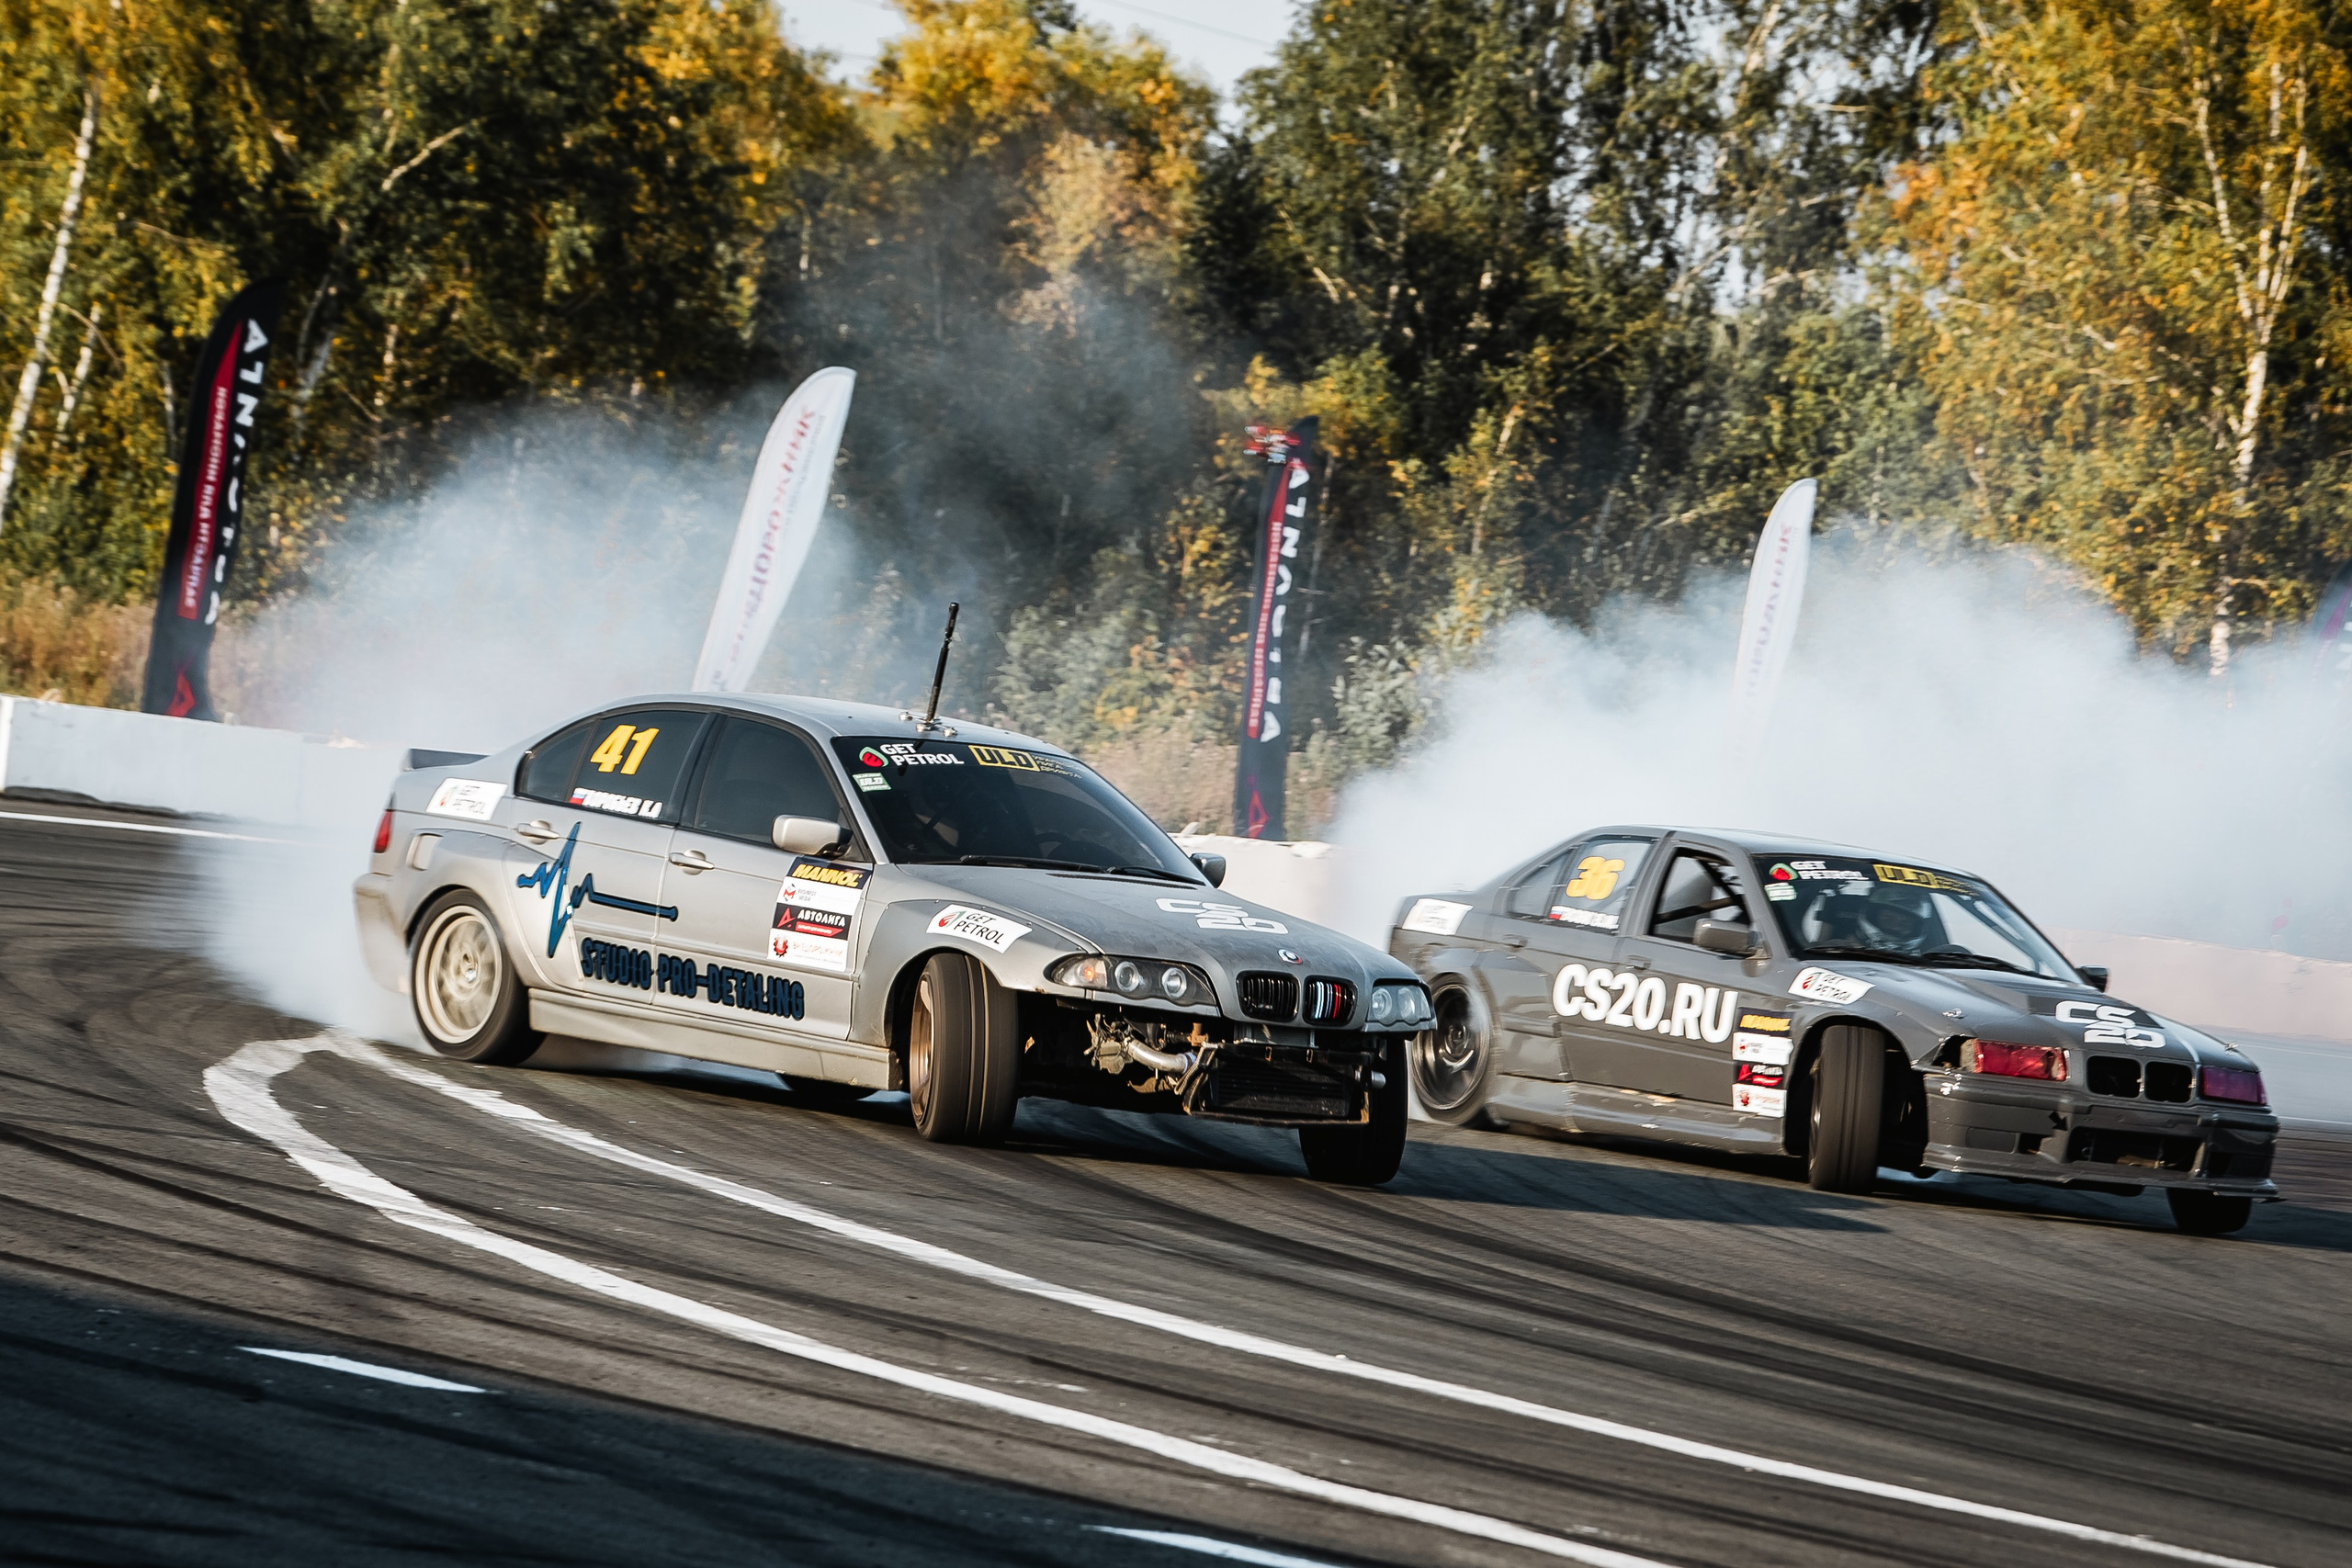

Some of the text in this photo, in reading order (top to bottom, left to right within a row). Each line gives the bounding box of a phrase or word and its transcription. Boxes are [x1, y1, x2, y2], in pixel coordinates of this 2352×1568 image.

[589, 724, 660, 775] 41
[879, 743, 917, 755] GET
[889, 753, 965, 766] PETROL
[973, 747, 1035, 768] ULD
[792, 863, 861, 888] MANNOL
[1566, 855, 1625, 900] 36
[797, 908, 846, 927] АВТОЛИГА
[966, 912, 996, 924] GET
[953, 919, 1004, 944] PETROL
[581, 937, 805, 1021] STUDIO PRO-DETALING
[1553, 964, 1739, 1043] CS20.RU
